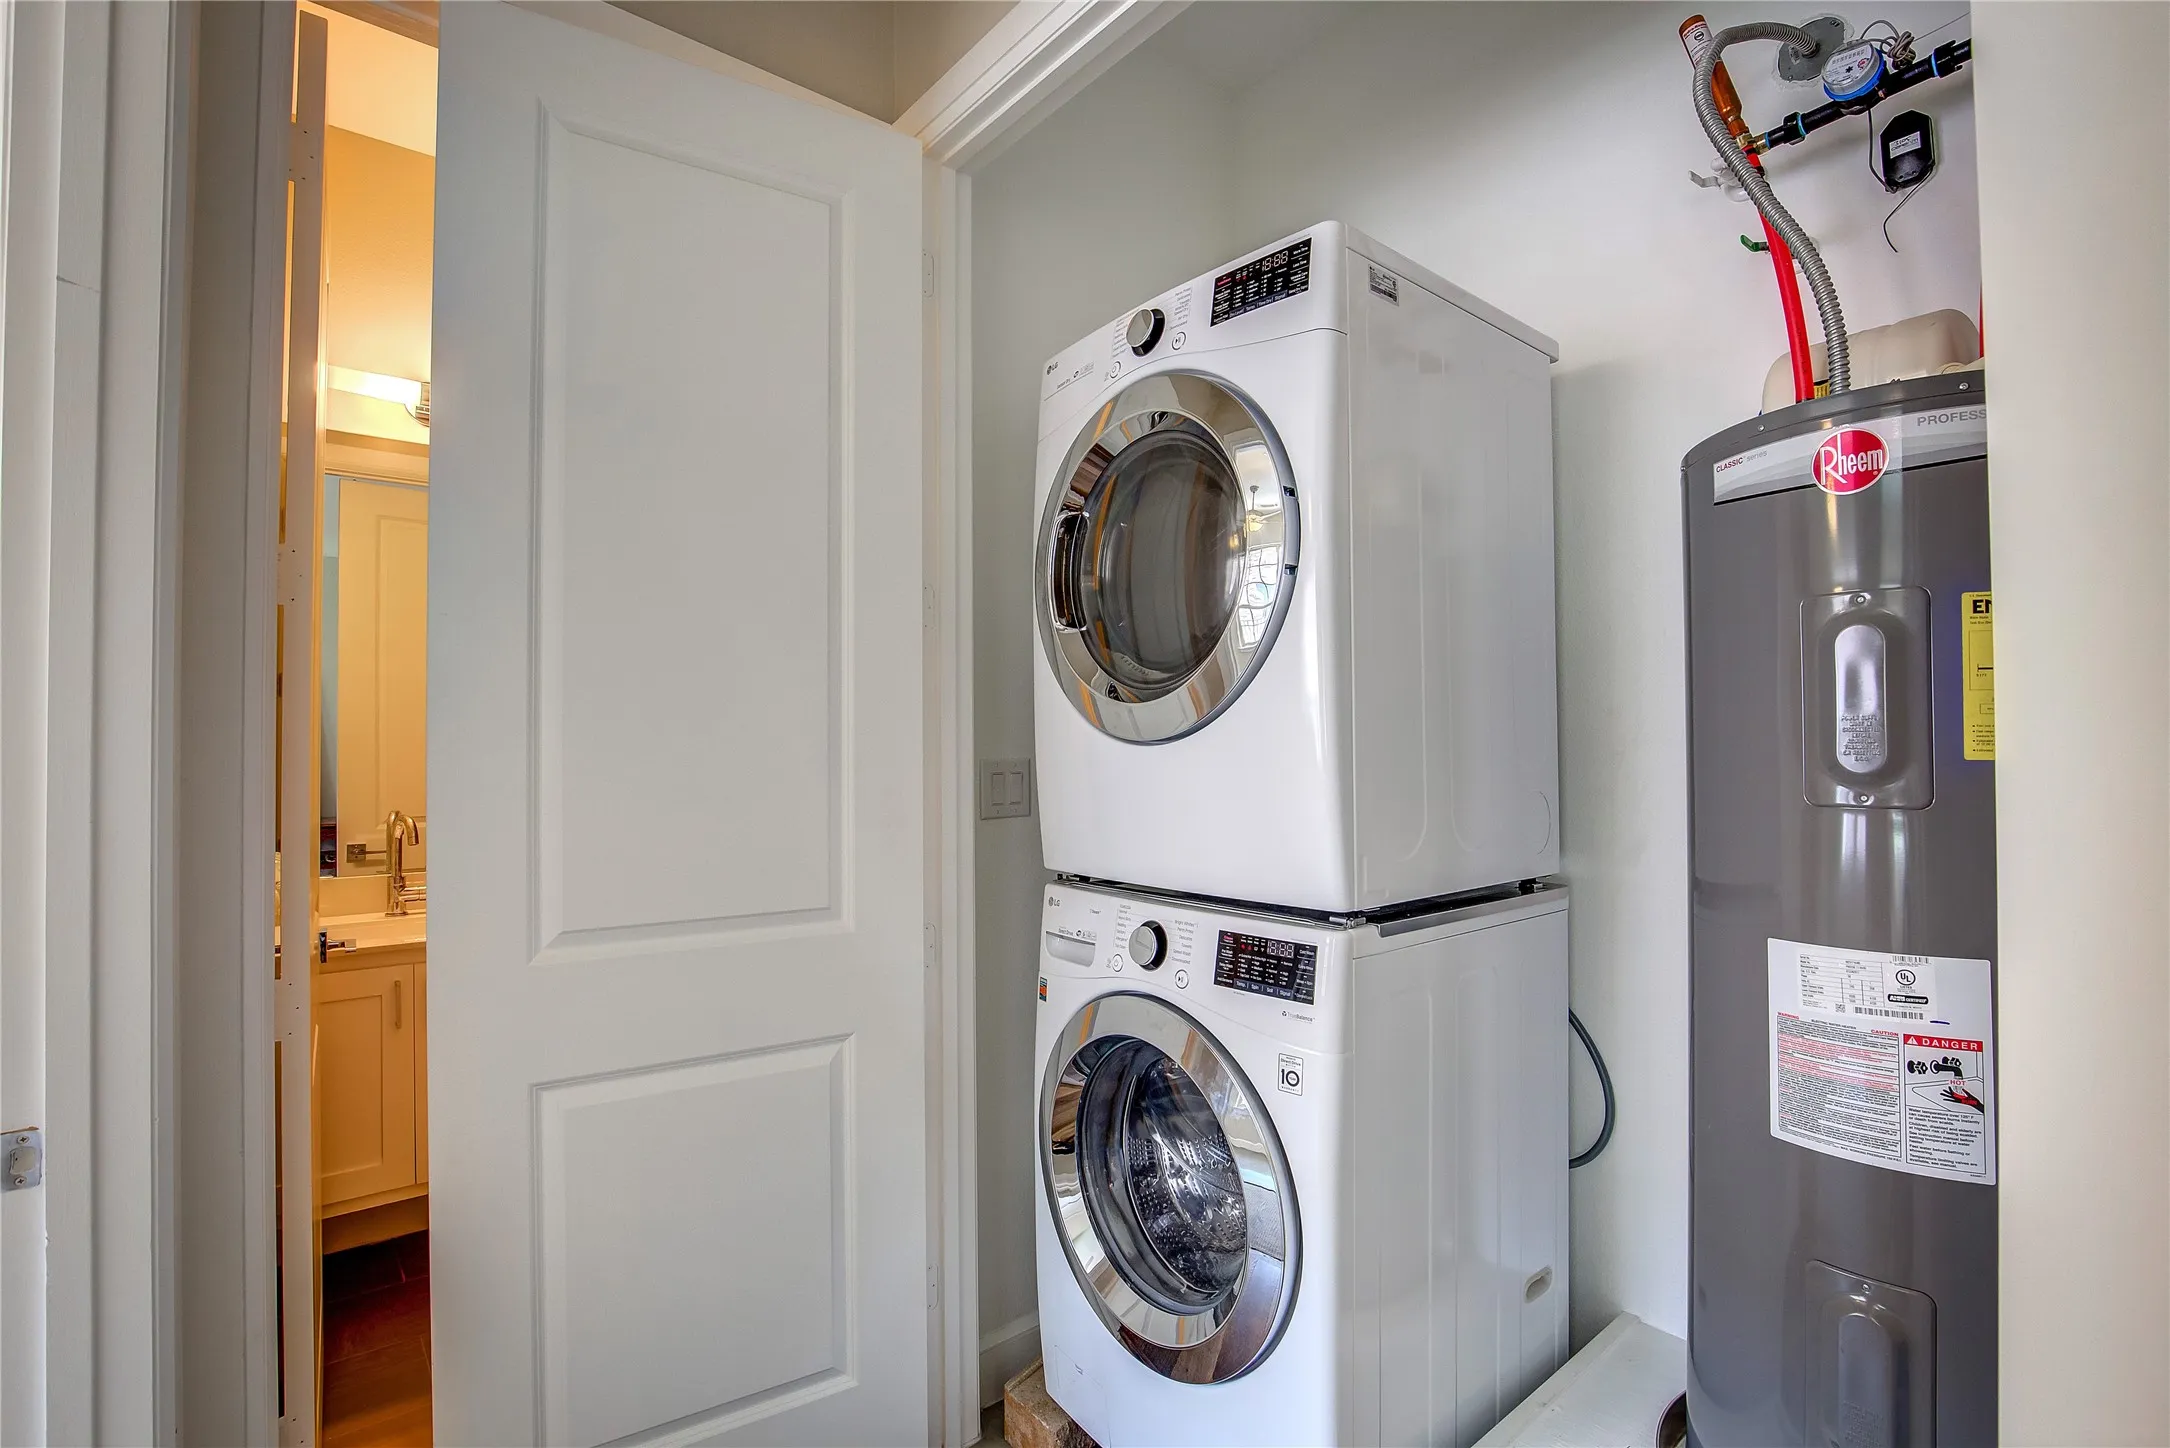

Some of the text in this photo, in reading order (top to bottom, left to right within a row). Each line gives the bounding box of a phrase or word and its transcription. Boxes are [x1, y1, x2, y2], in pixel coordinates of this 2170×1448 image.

[1917, 409, 1987, 427] PROFESS
[1716, 450, 1767, 473] CLASSIC series
[1820, 434, 1883, 485] Rheem
[1900, 973, 1911, 982] UL
[1922, 1038, 1978, 1050] DANGER
[1281, 1069, 1299, 1087] 10
